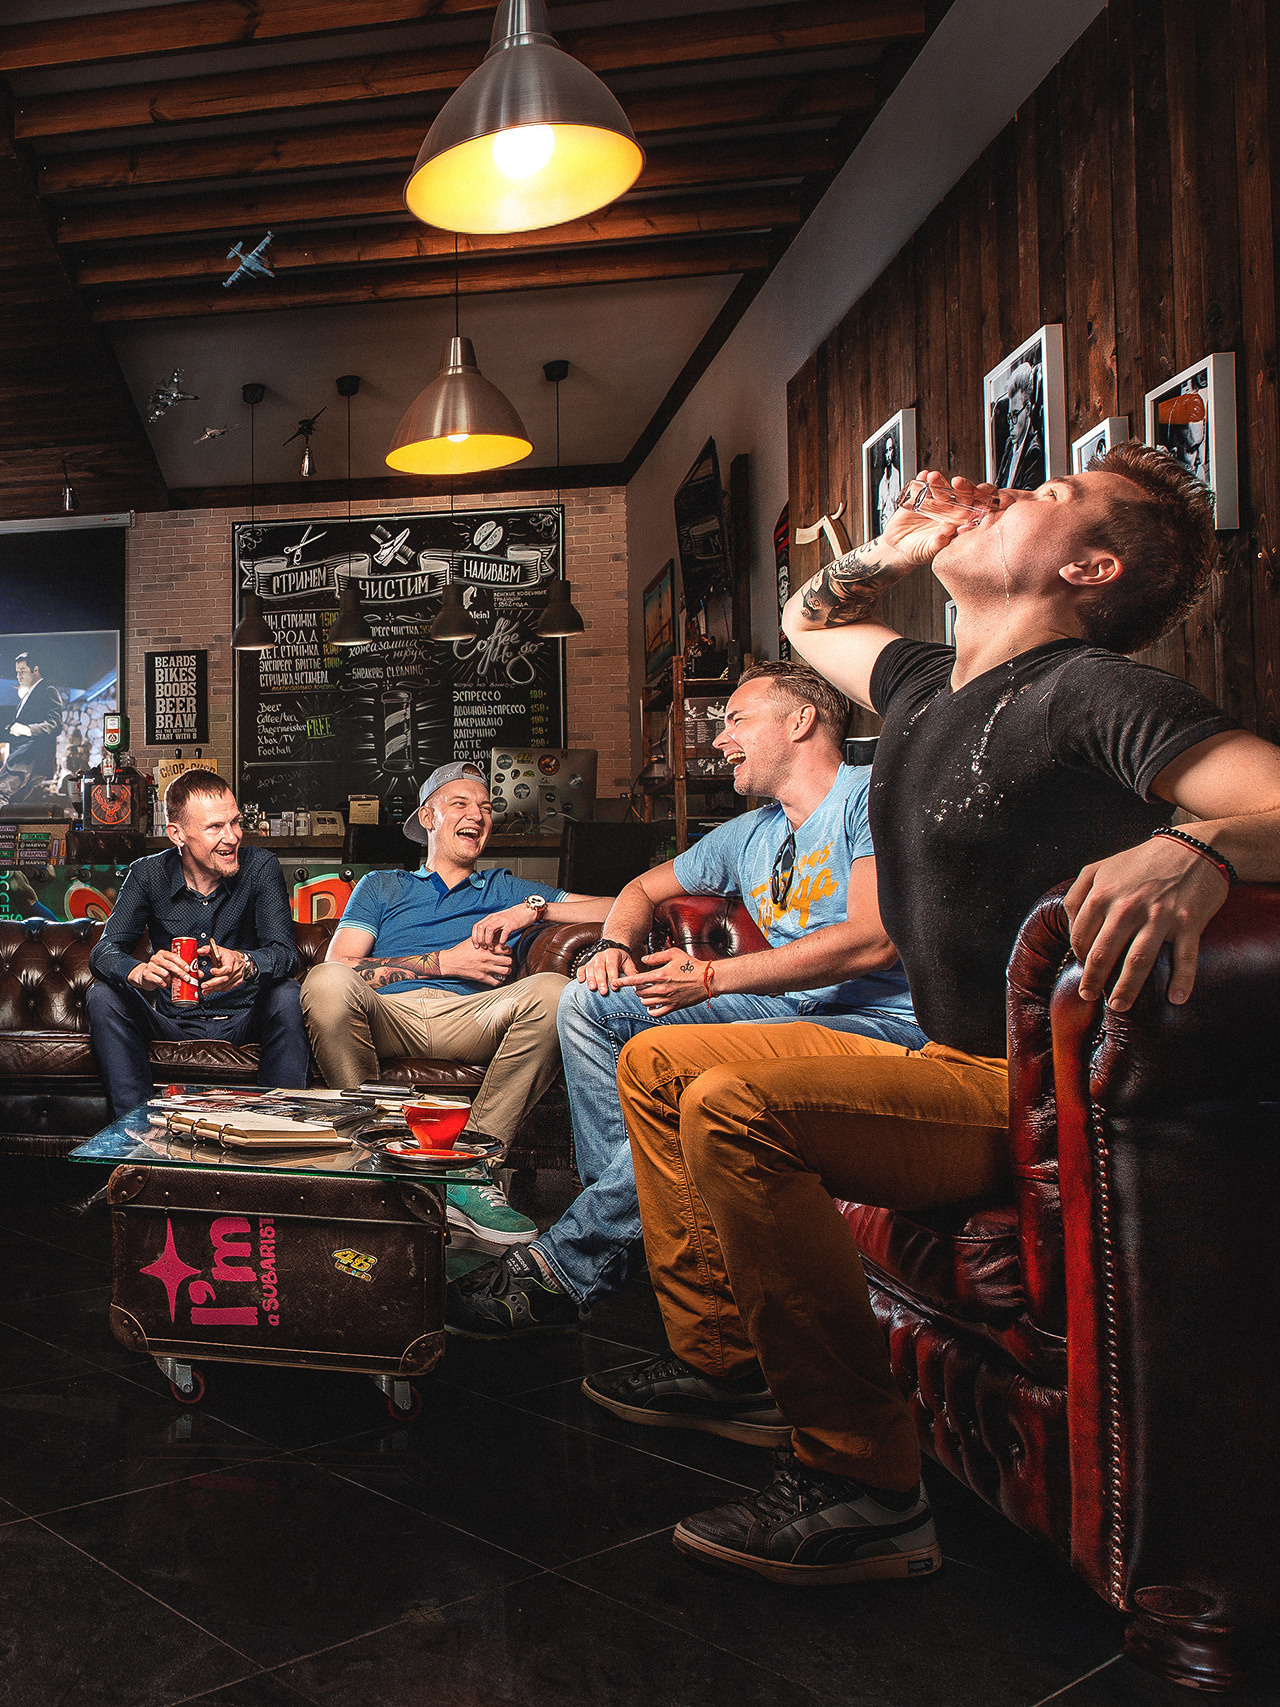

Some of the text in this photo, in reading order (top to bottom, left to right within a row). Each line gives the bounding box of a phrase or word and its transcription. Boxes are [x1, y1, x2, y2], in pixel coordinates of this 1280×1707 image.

[463, 560, 521, 583] НАЛИВАЕМ
[272, 566, 327, 595] СТРИЖЕМ
[358, 575, 429, 599] ЧИСТИМ
[453, 617, 520, 675] Coffee
[155, 655, 196, 668] BEARDS
[155, 667, 197, 682] BIKES
[386, 664, 424, 678] CLEANING
[155, 682, 197, 697] BOOBS
[452, 690, 501, 702] ЭСПРЕССО
[155, 697, 197, 714] BEER
[258, 702, 282, 713] Beer
[487, 704, 526, 716] ЭСПРЕССО
[155, 713, 197, 729] BRAW
[306, 716, 331, 737] FREE
[453, 717, 503, 727] АМЕРИКАНО
[175, 732, 191, 740] WITH
[258, 723, 307, 737] Jagermeister
[453, 728, 497, 739] КАПУЧИНО
[258, 746, 292, 756] Football
[453, 740, 482, 749] ЛАТТЕ
[453, 750, 472, 760] ГОР.
[258, 1217, 279, 1312] SUBARIST
[333, 1250, 376, 1272] 46
[189, 1216, 258, 1325] I'm
